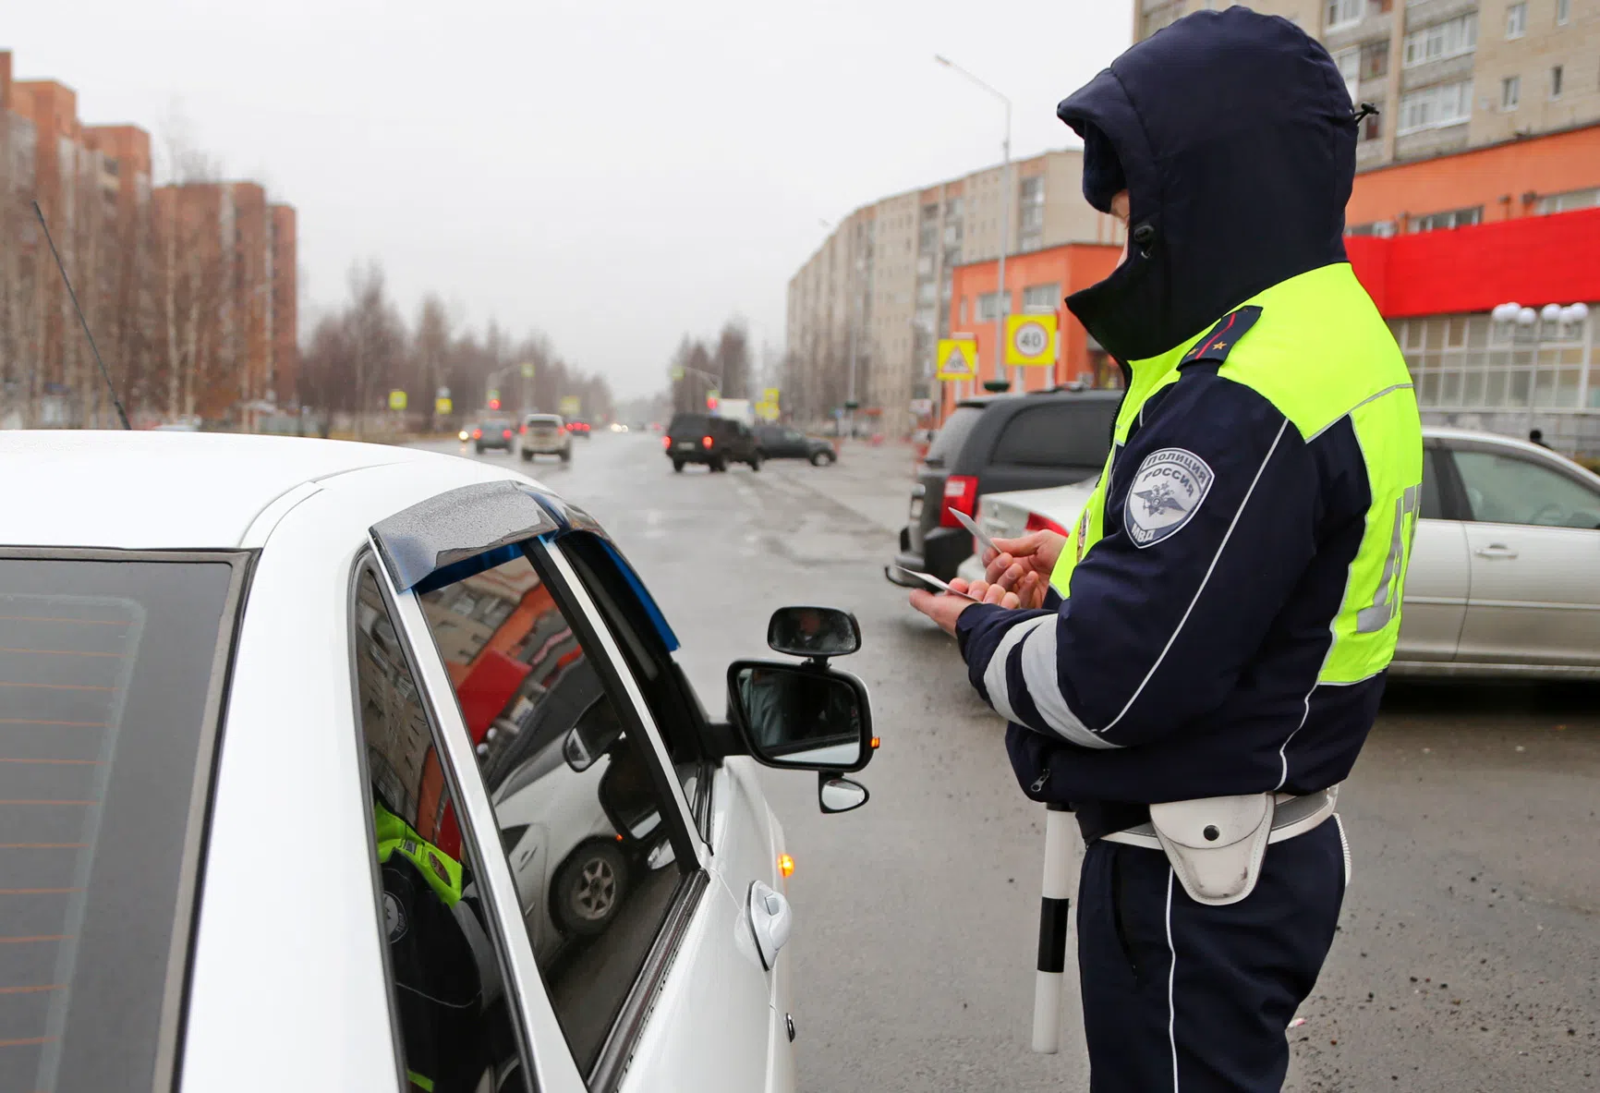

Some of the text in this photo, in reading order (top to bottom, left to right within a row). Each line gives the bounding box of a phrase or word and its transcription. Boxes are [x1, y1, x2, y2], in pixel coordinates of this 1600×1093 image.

[1020, 332, 1042, 347] 40
[1146, 453, 1207, 484] ПОЛИЦИЯ
[1142, 468, 1195, 498] РОССИЯ
[1131, 523, 1155, 543] МВД
